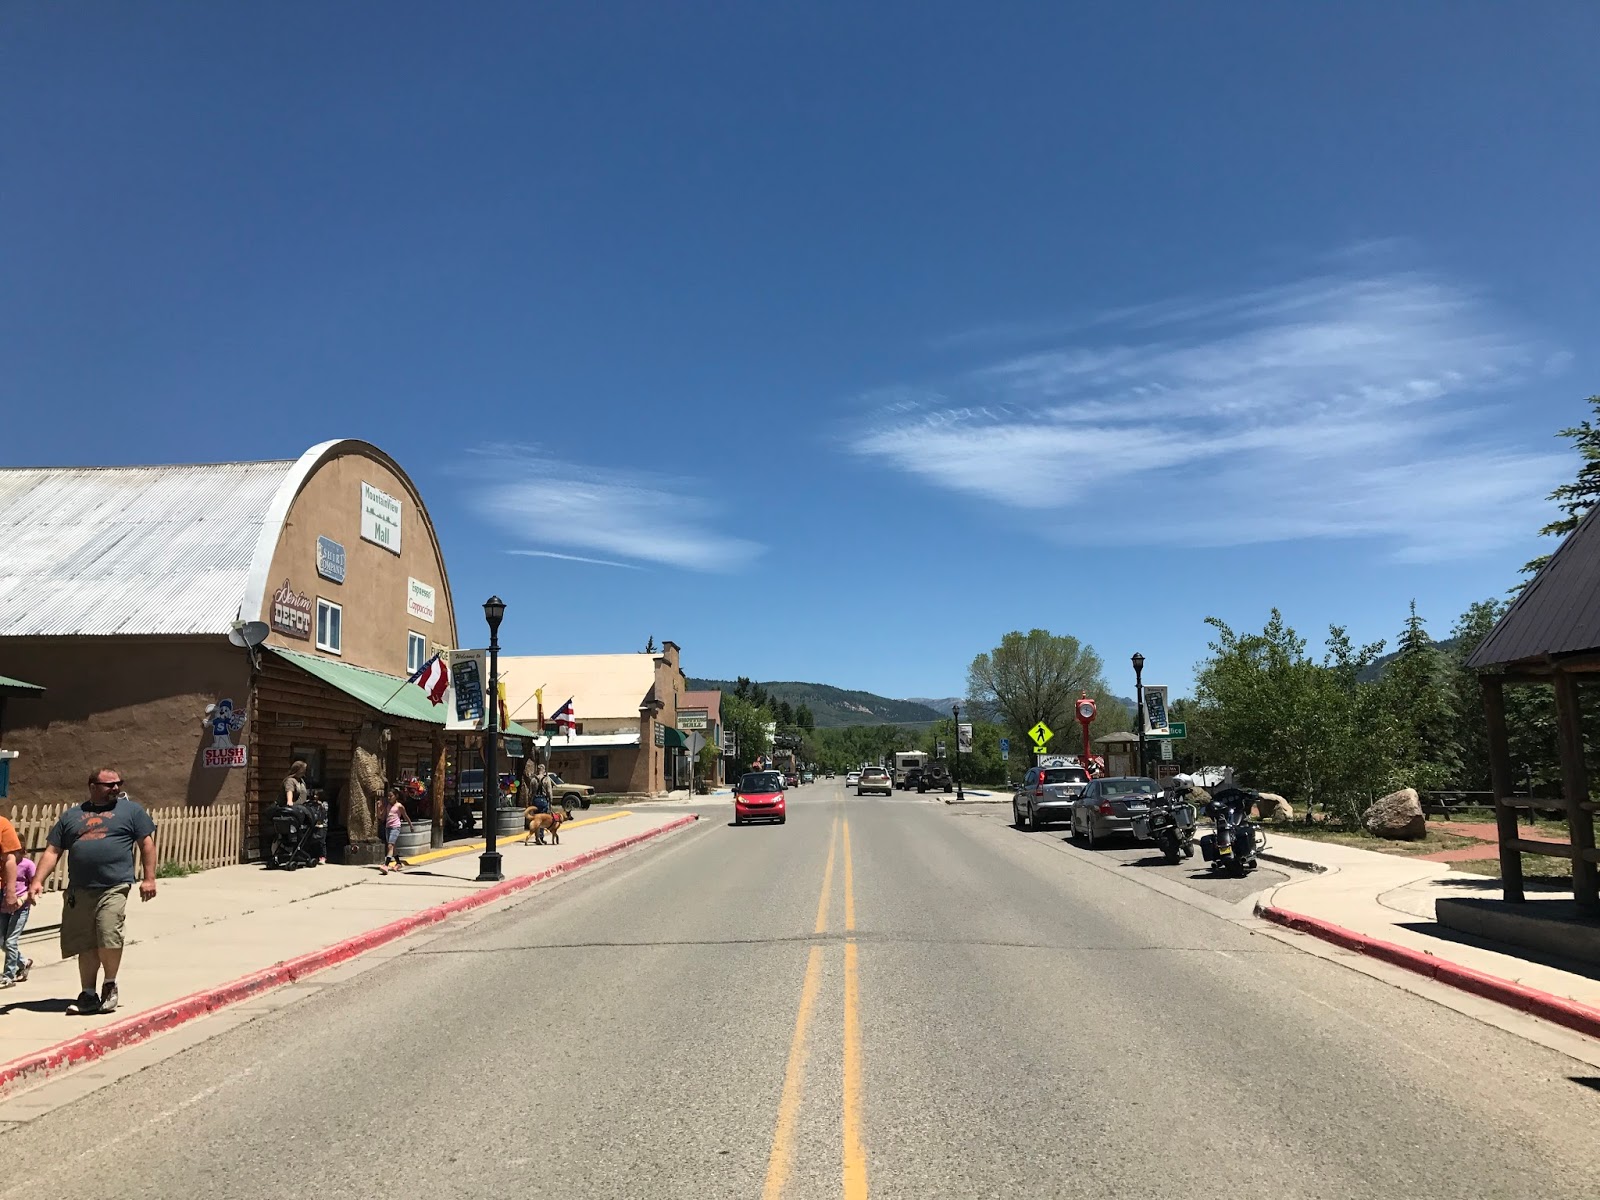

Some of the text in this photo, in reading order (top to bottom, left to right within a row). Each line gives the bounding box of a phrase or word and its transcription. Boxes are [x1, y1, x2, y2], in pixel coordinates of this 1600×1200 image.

[374, 522, 390, 544] Mall
[323, 547, 345, 566] SHIRT
[275, 580, 312, 611] Denim
[274, 602, 311, 632] DEPOT
[205, 747, 244, 758] SLUSH
